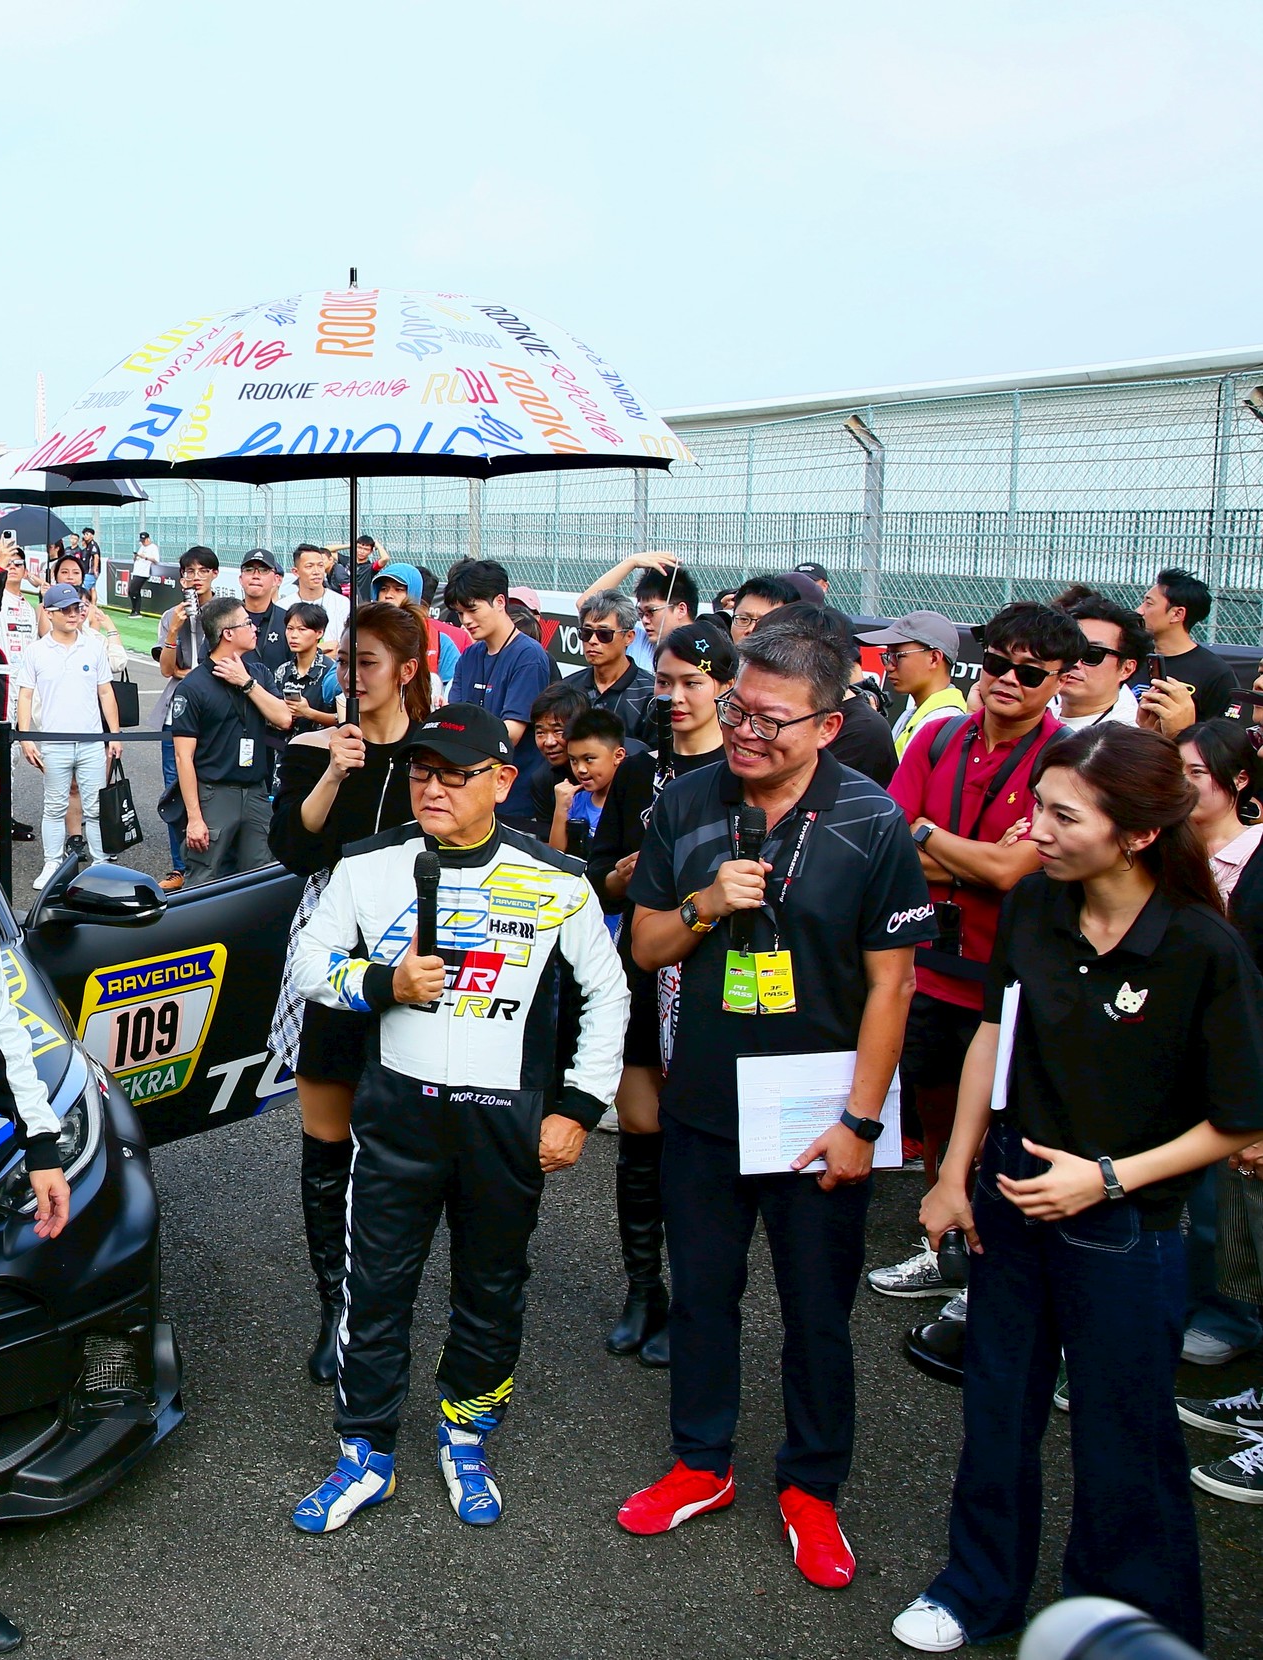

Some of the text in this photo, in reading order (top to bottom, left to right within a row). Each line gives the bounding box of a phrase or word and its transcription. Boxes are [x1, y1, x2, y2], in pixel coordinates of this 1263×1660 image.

[471, 305, 560, 360] ROOKIE
[539, 363, 625, 447] RACING
[238, 378, 411, 400] ROOKIE RACING
[115, 580, 129, 596] GR
[778, 820, 811, 903] TOYOTA GAZOO Racing
[495, 898, 534, 909] RAVENOL
[488, 918, 518, 936] H&R
[107, 961, 206, 996] RAVENOL
[728, 990, 753, 998] PASS
[764, 990, 789, 998] PASS
[114, 1000, 180, 1068] 109
[120, 1066, 177, 1101] EKRA
[449, 1091, 496, 1105] MORIZO
